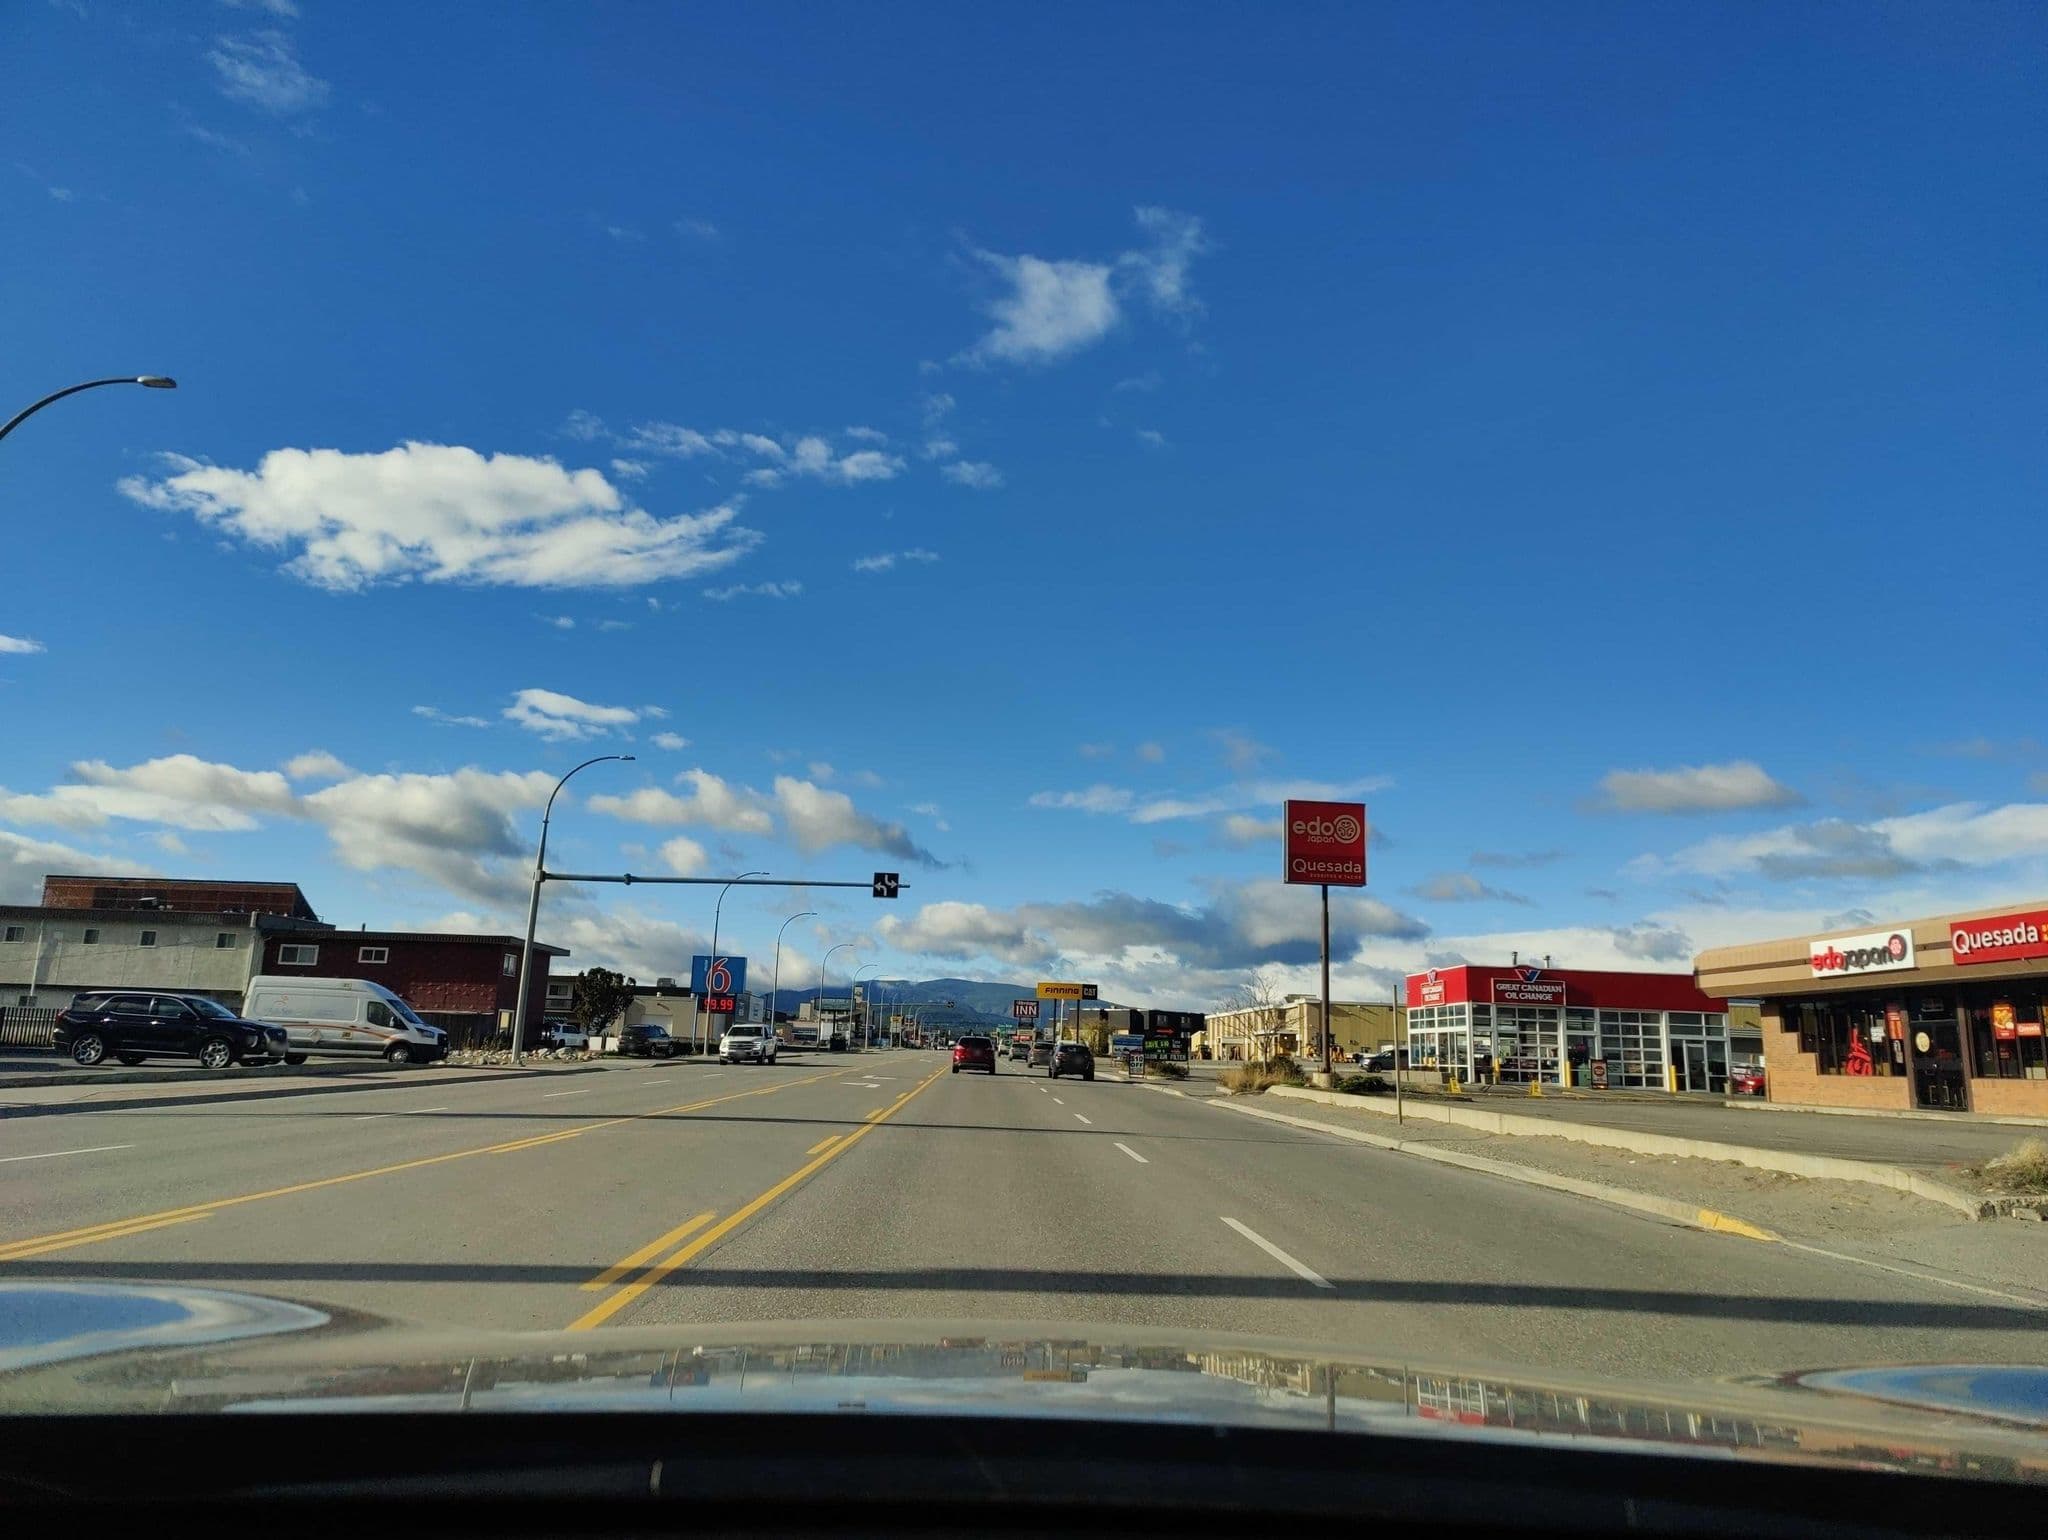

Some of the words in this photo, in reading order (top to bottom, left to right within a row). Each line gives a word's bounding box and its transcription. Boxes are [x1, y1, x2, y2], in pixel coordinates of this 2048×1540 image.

[1293, 816, 1335, 836] edo
[1292, 859, 1362, 874] Quesada
[1952, 922, 2039, 954] Quesada
[706, 958, 732, 993] 6
[1083, 988, 1096, 996] CAT
[1496, 983, 1520, 991] GREAT
[1521, 984, 1562, 993] CANADIAN
[1519, 993, 1553, 1001] CHANGE
[1016, 1005, 1037, 1015] INN
